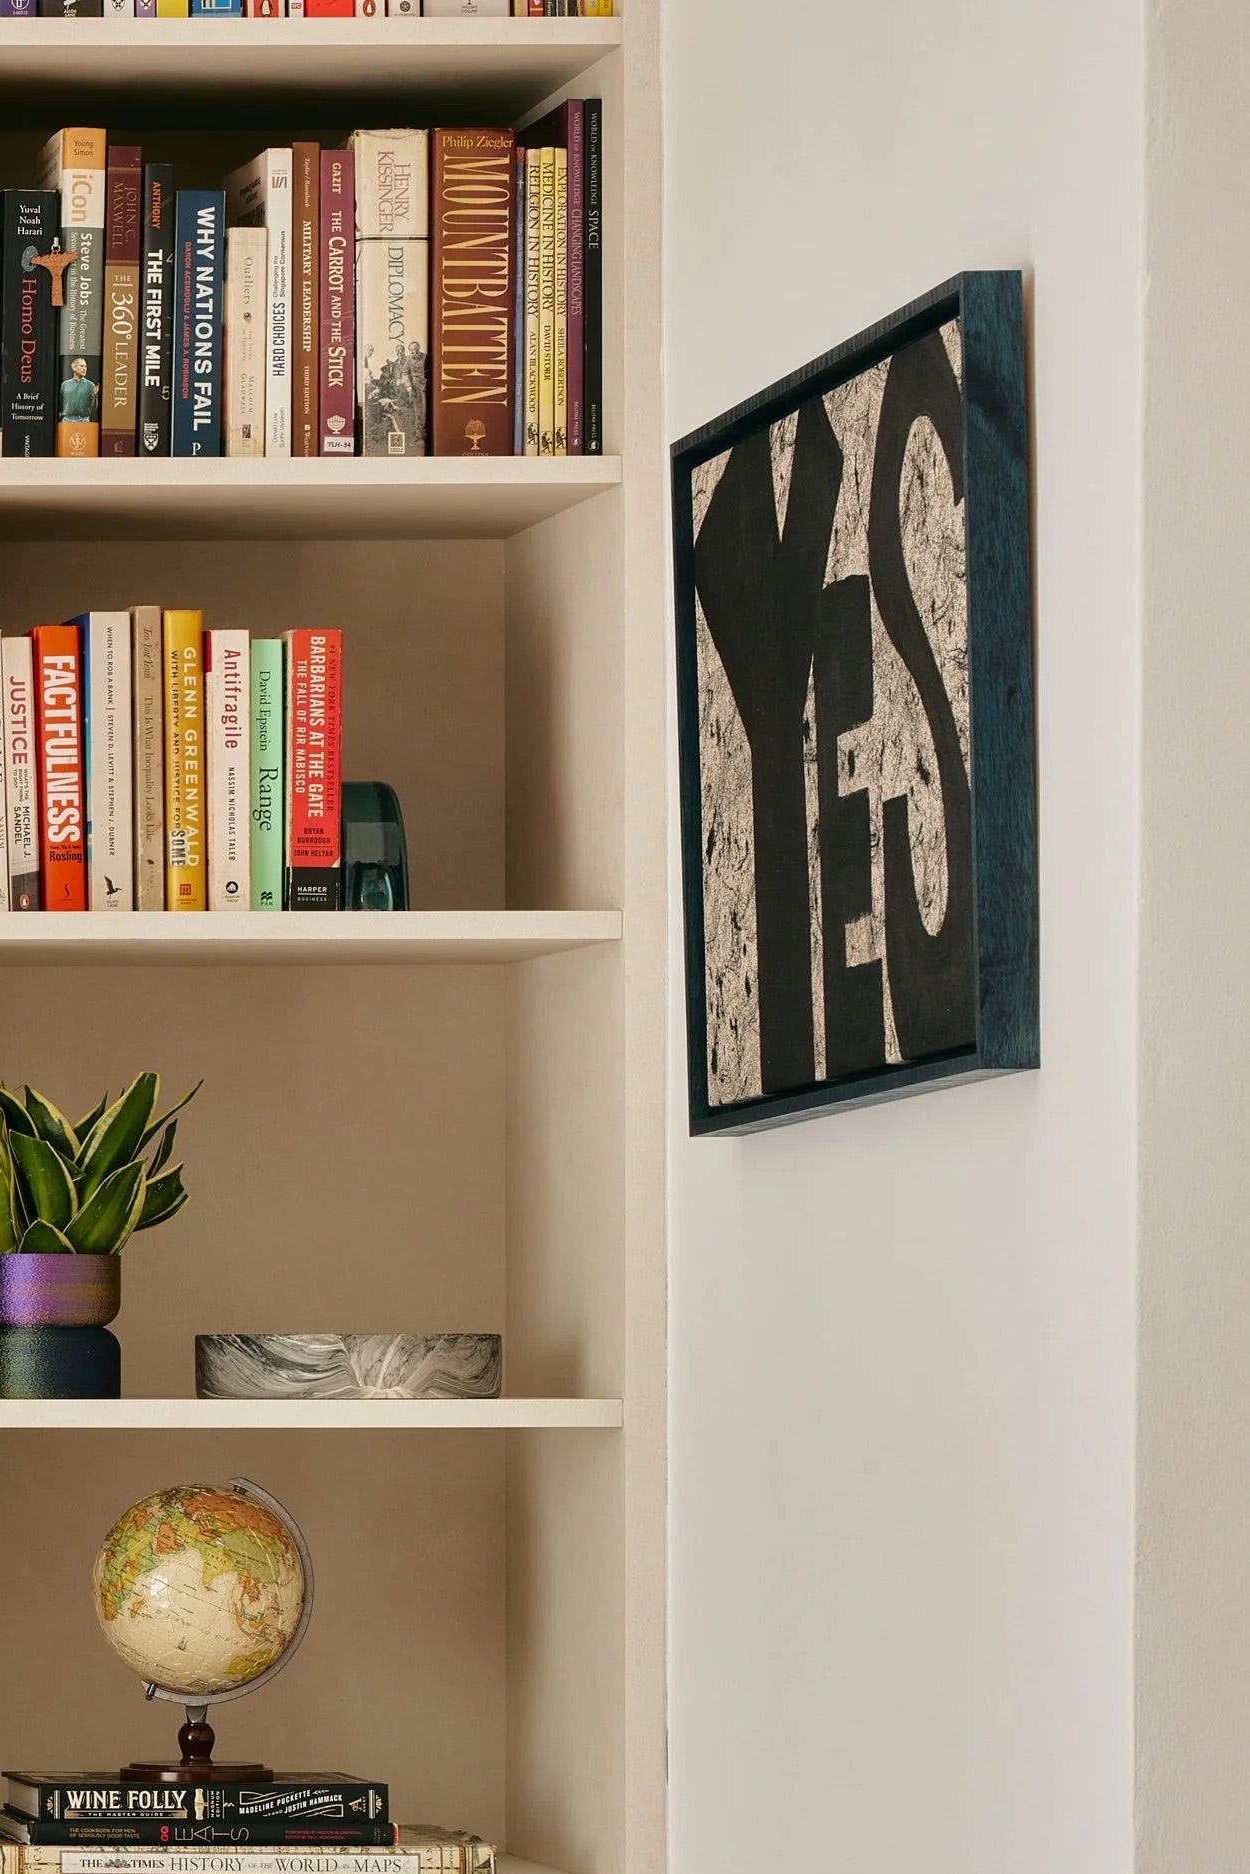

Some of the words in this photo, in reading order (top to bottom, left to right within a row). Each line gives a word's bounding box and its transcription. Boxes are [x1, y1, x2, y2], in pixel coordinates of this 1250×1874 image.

[73, 140, 94, 150] Young
[442, 135, 474, 149] Philip
[476, 136, 513, 149] Ziegler
[71, 174, 93, 222] iCon
[125, 187, 136, 225] JOHN
[152, 181, 162, 229] ANTHONY
[378, 151, 394, 233] KISSINGER
[394, 164, 411, 220] HENRY
[113, 182, 124, 248] MAXWELL
[125, 229, 136, 242] C.
[197, 206, 216, 260] WHY
[331, 210, 342, 232] THE
[80, 232, 93, 271] Steve
[147, 249, 163, 284] THE
[303, 220, 312, 276] MILITARY
[329, 236, 346, 293] CARROT
[79, 275, 93, 306] Jobs
[243, 257, 254, 305] Outliers
[388, 247, 405, 346] DIPLOMACY
[441, 154, 510, 408] MOUNTBATTEN
[21, 278, 37, 335] Homo
[79, 309, 87, 321] The
[111, 292, 134, 340] 360°
[146, 289, 162, 341] FIRST
[194, 266, 214, 374] NATIONS
[272, 302, 285, 346] CHOICES
[302, 281, 312, 352] LEADERSHIP
[331, 295, 341, 319] AND
[79, 323, 87, 350] Greatest
[331, 321, 342, 343] THE
[20, 339, 37, 384] Deus
[114, 342, 129, 408] LEADER
[144, 345, 161, 387] MILE
[272, 348, 285, 377] HARD
[328, 346, 347, 388] STICK
[193, 382, 212, 431] FAIL
[107, 650, 114, 660] TO
[183, 647, 198, 718] GLENN
[221, 650, 242, 749] Antifragile
[259, 671, 271, 706] David
[310, 637, 326, 727] BARBARIANS
[10, 675, 28, 765] JUSTICE
[693, 317, 977, 1097] YES
[42, 655, 81, 844] FACTFULNESS
[256, 709, 271, 752] Epstein
[309, 731, 325, 748] AT
[309, 751, 324, 779] THE
[184, 729, 200, 867] GREENWALD
[252, 766, 279, 832] Range
[308, 784, 323, 819] GATE
[23, 806, 31, 849] MICHAEL
[23, 850, 31, 859] J.
[49, 851, 83, 863] Rosling
[294, 849, 309, 857] JOHN
[66, 1790, 122, 1809] WINE
[128, 1790, 187, 1809] FOLLY
[238, 1801, 274, 1815] MADELINE
[276, 1789, 311, 1805] PUCKETTE
[284, 1800, 307, 1814] JUSTIN
[309, 1794, 343, 1808] HAMMACK
[79, 1859, 104, 1868] THE
[130, 1859, 166, 1868] TIMES
[170, 1857, 246, 1872] HISTORY
[275, 1857, 338, 1872] WORLD
[353, 1857, 402, 1872] MAPS
